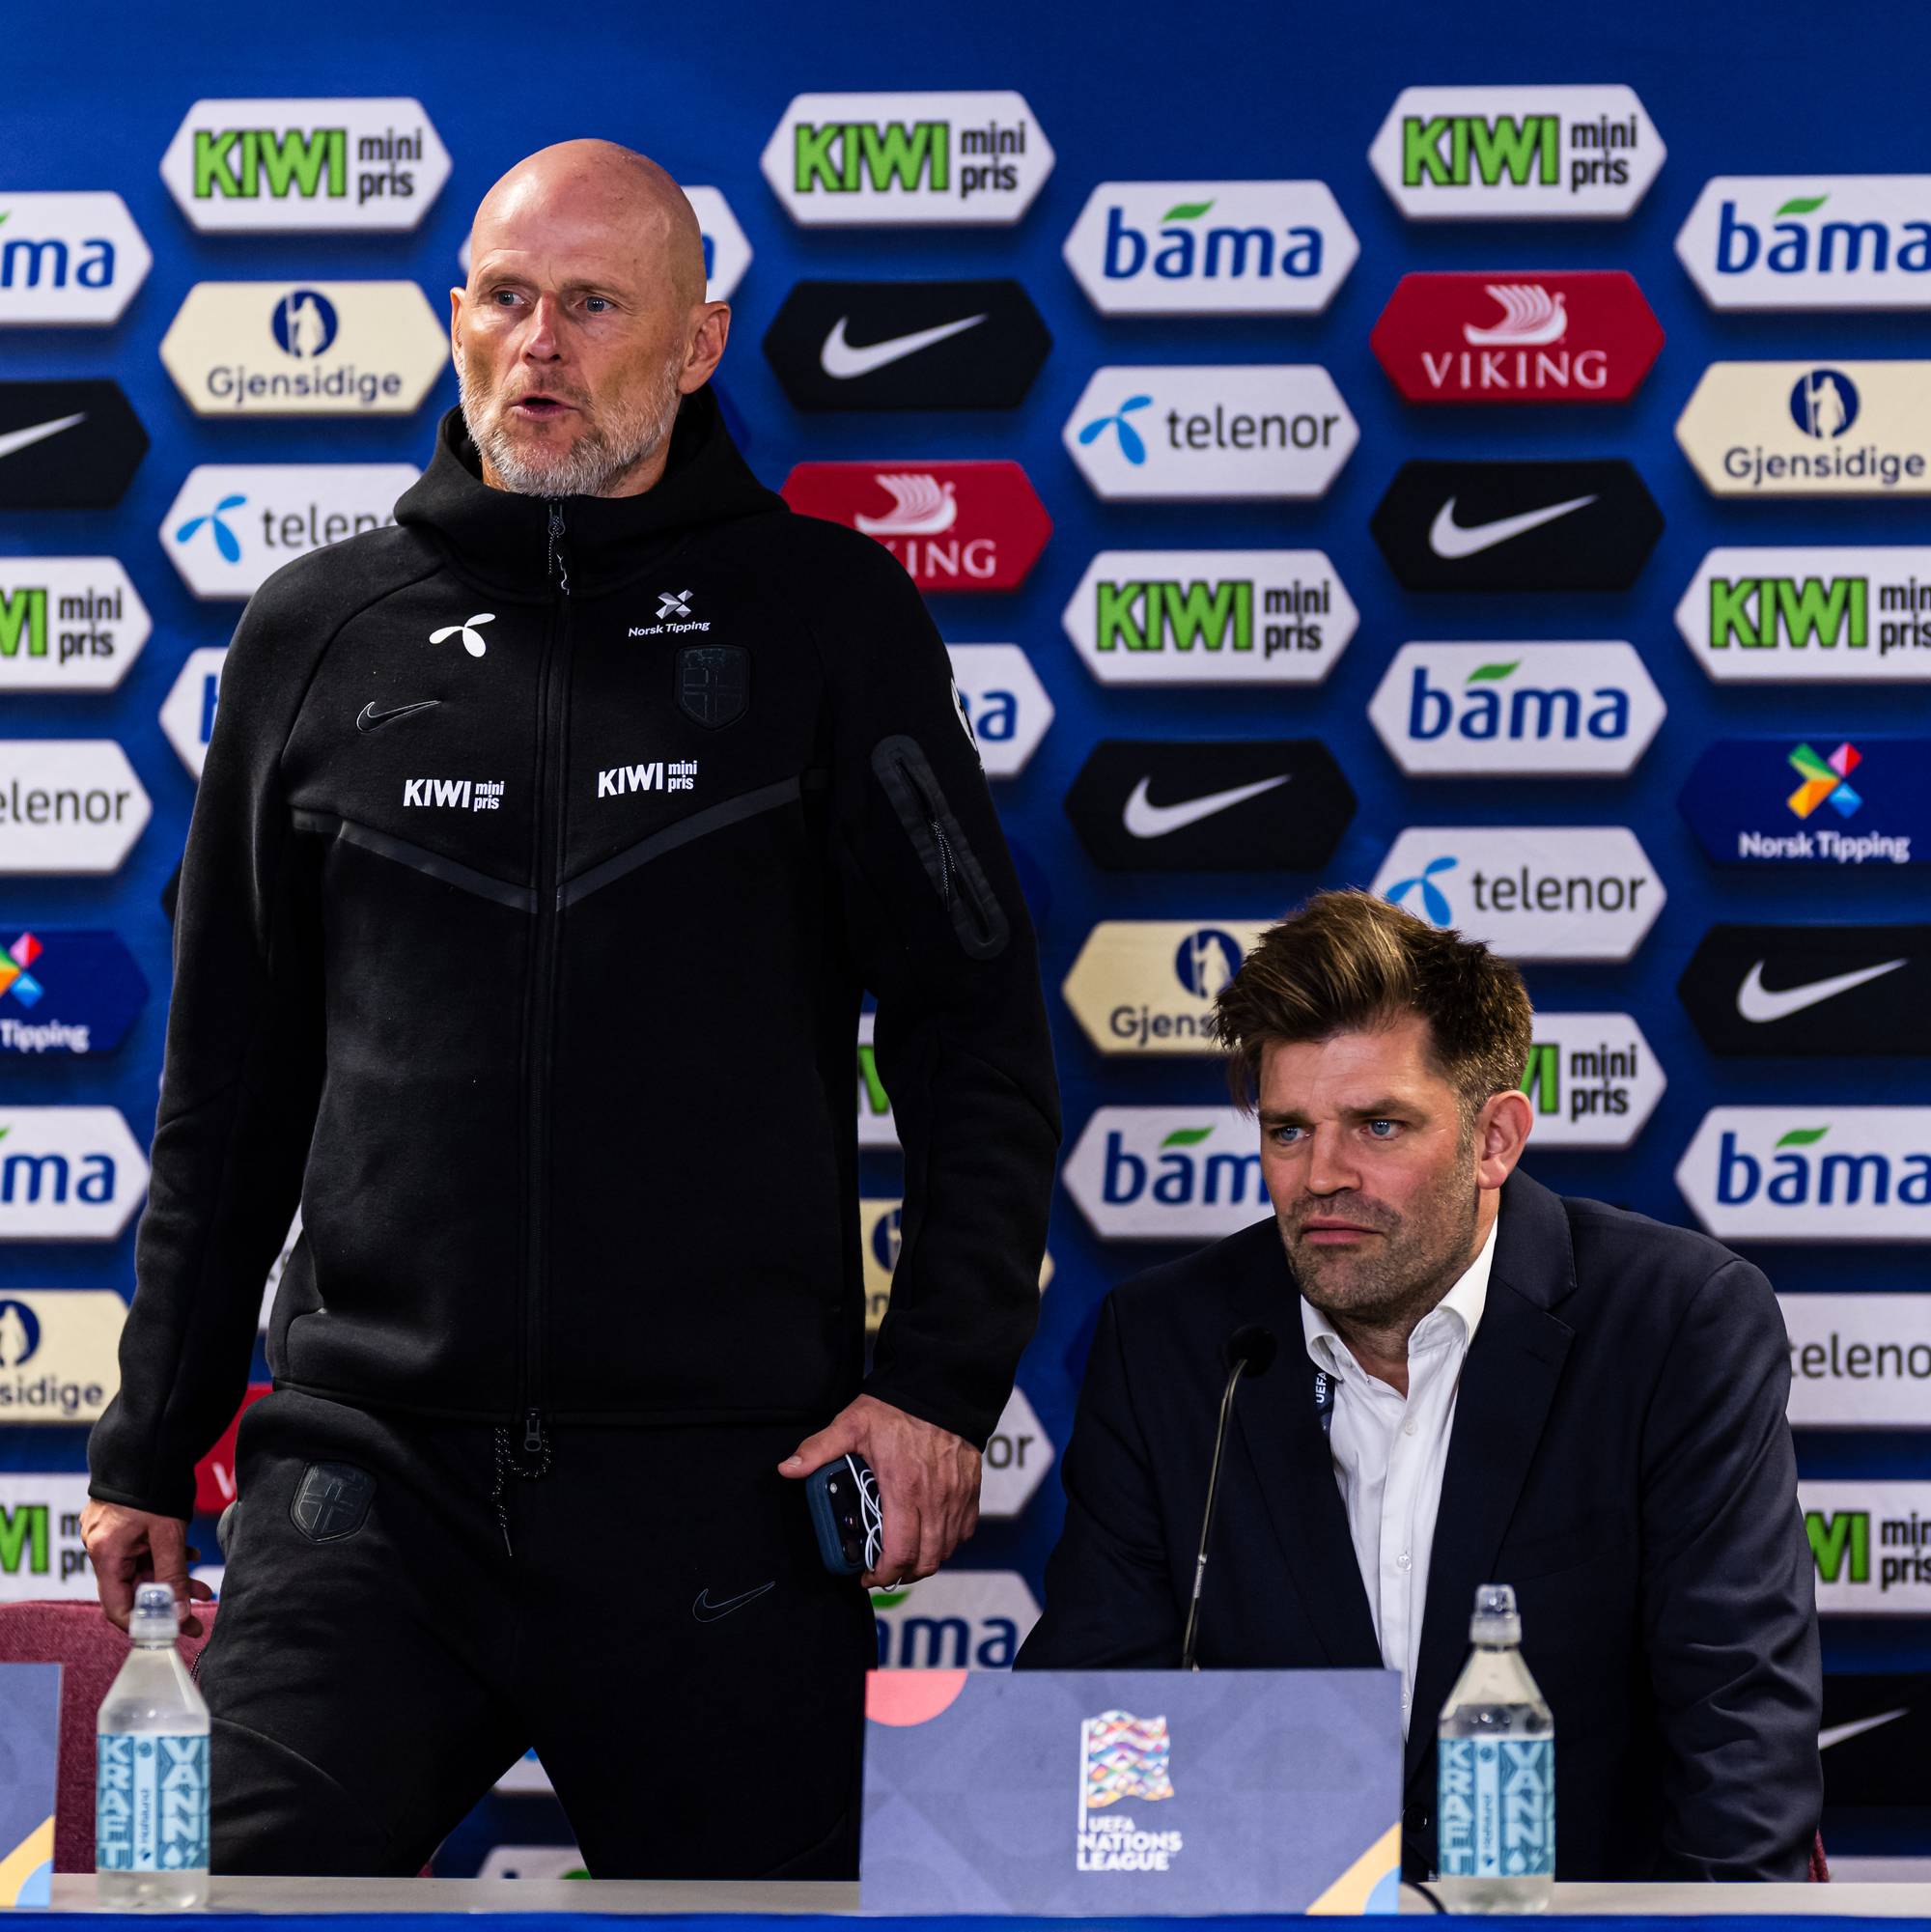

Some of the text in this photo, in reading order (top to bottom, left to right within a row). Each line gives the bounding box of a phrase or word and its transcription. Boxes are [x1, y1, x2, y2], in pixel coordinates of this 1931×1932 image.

[358, 127, 422, 160] mini
[961, 122, 1025, 154] mini
[1401, 113, 1561, 188] KIWI
[1571, 115, 1637, 148] mini
[192, 127, 349, 200] KIWI
[793, 120, 951, 194] KIWI
[1571, 149, 1630, 192] pris
[358, 161, 414, 203] pris
[961, 156, 1018, 197] pris
[1103, 206, 1324, 278] bama
[0, 238, 116, 290] ma
[208, 366, 401, 405] Gjensidige
[1421, 350, 1608, 388] VIKING
[1165, 405, 1340, 449] telenor
[1724, 446, 1925, 485] Gjensidige
[887, 539, 996, 577] ING
[59, 586, 122, 620] mini
[1264, 580, 1330, 613] mini
[1880, 575, 1931, 610] min
[628, 621, 711, 637] Norsk Tipping
[1095, 578, 1255, 654] KIWI
[1708, 575, 1869, 650] KIWI
[59, 621, 114, 665] pris
[1264, 616, 1322, 658] pris
[1408, 666, 1630, 741] bama
[598, 762, 664, 798] KIWI
[667, 760, 697, 776] mini
[667, 774, 694, 793] pris
[403, 778, 472, 808] KIWI
[473, 794, 499, 812] pris
[475, 780, 504, 796] mini
[1738, 830, 1910, 861] Norsk Tipping
[1471, 866, 1646, 911] telenor
[0, 1020, 90, 1052] Tipping
[1570, 1044, 1637, 1078] mini
[1570, 1079, 1629, 1123] pris
[0, 1153, 117, 1205] ma
[1103, 1131, 1272, 1206] bam
[1315, 1372, 1327, 1404] UEFA
[1882, 1511, 1931, 1546] min
[876, 1616, 1019, 1668] ma
[160, 1738, 201, 1843] VANN
[1503, 1742, 1544, 1848] VANN
[1077, 1832, 1183, 1852] NATIONS
[1088, 1816, 1135, 1833] UEFA
[1077, 1852, 1170, 1871] LEAGUE
